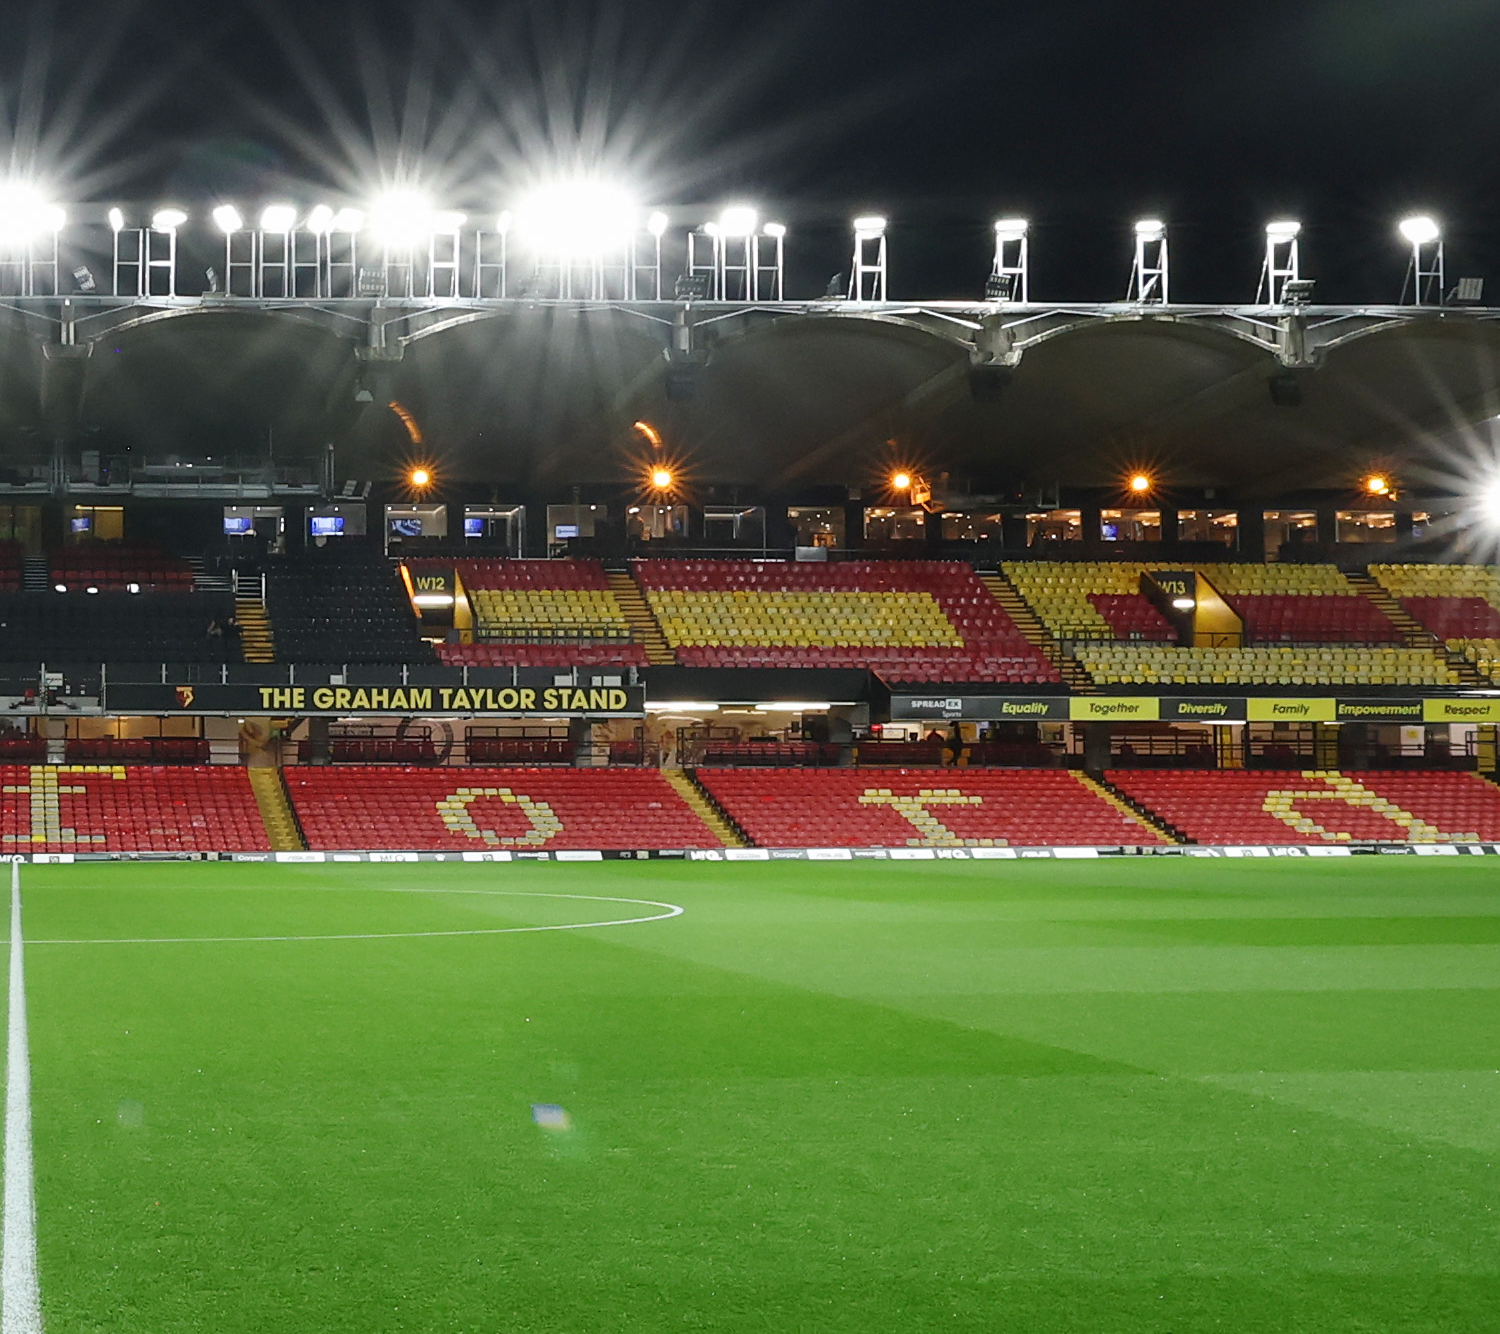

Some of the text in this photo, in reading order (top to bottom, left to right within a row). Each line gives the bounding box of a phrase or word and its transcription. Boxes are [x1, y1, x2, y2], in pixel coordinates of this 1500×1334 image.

[416, 577, 445, 590] W12
[259, 688, 627, 709] THE GRAHAM TAYLOR STAND
[1002, 702, 1049, 714] Equality
[1089, 703, 1139, 715] Together
[1178, 703, 1227, 715] Diversity
[1272, 704, 1310, 716] Family
[1338, 704, 1421, 716] Empowerment
[1444, 704, 1491, 716] Respect
